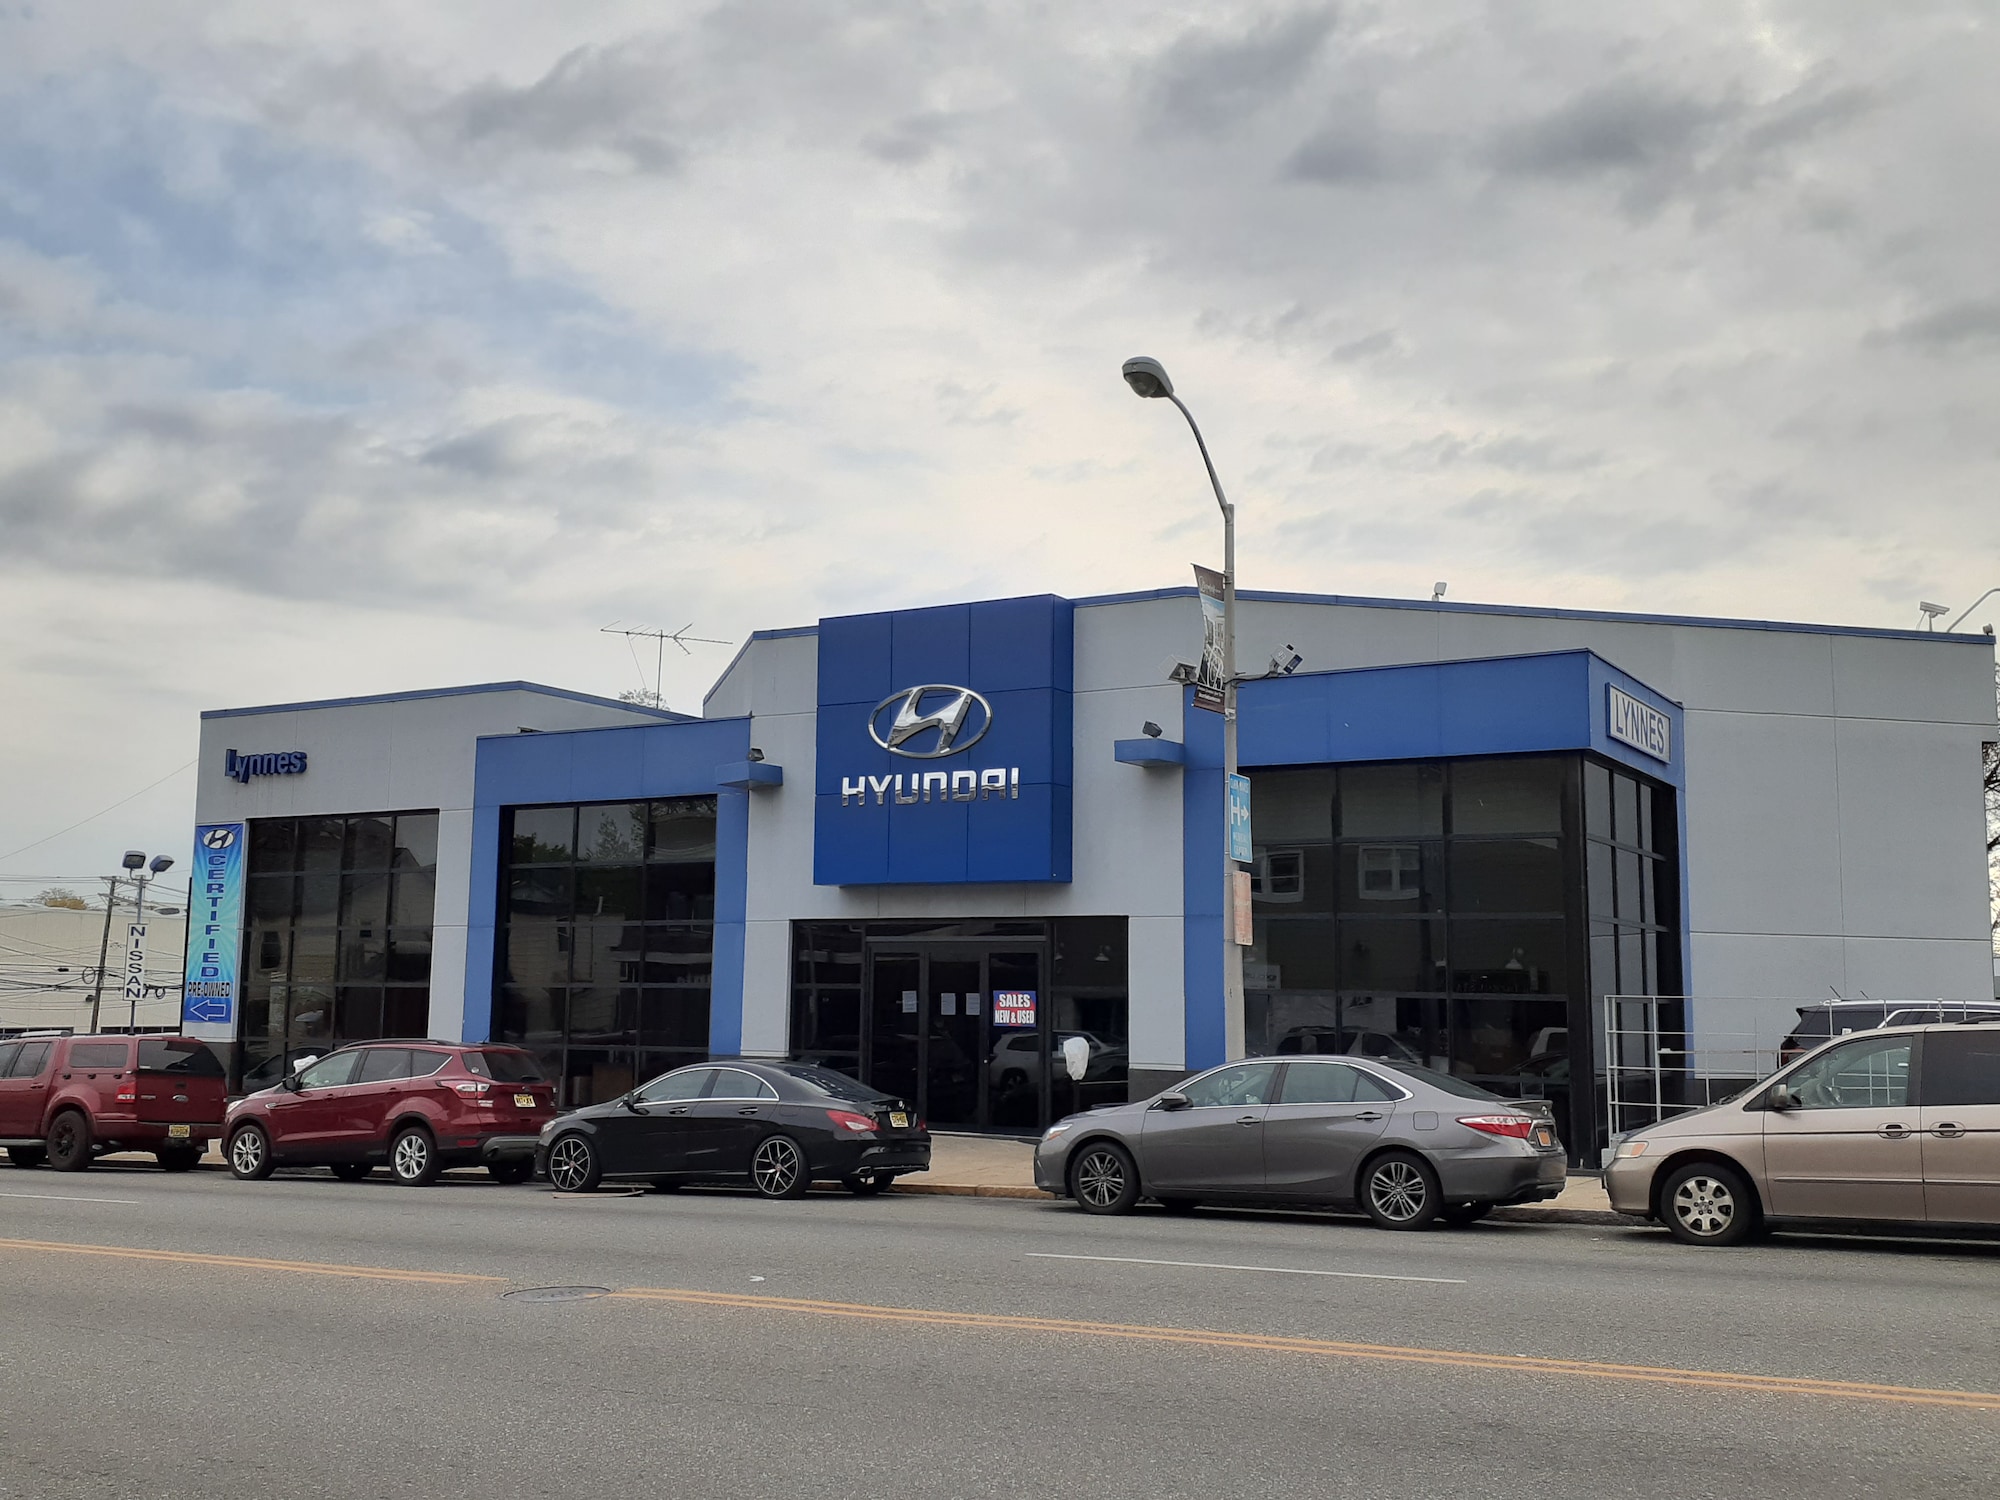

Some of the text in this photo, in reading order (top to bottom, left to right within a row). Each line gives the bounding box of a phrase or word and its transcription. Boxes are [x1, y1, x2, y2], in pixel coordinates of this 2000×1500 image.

[1616, 694, 1664, 754] LYNNES
[225, 748, 307, 784] Lynnes
[842, 767, 1020, 807] HYUNDAI
[1230, 794, 1241, 826] H
[200, 855, 227, 979] CERTIFIED
[126, 926, 146, 998] NISSAN
[187, 981, 231, 998] PRE-OWNED
[999, 994, 1031, 1008] SALES
[994, 1010, 1035, 1024] NEW & USED
